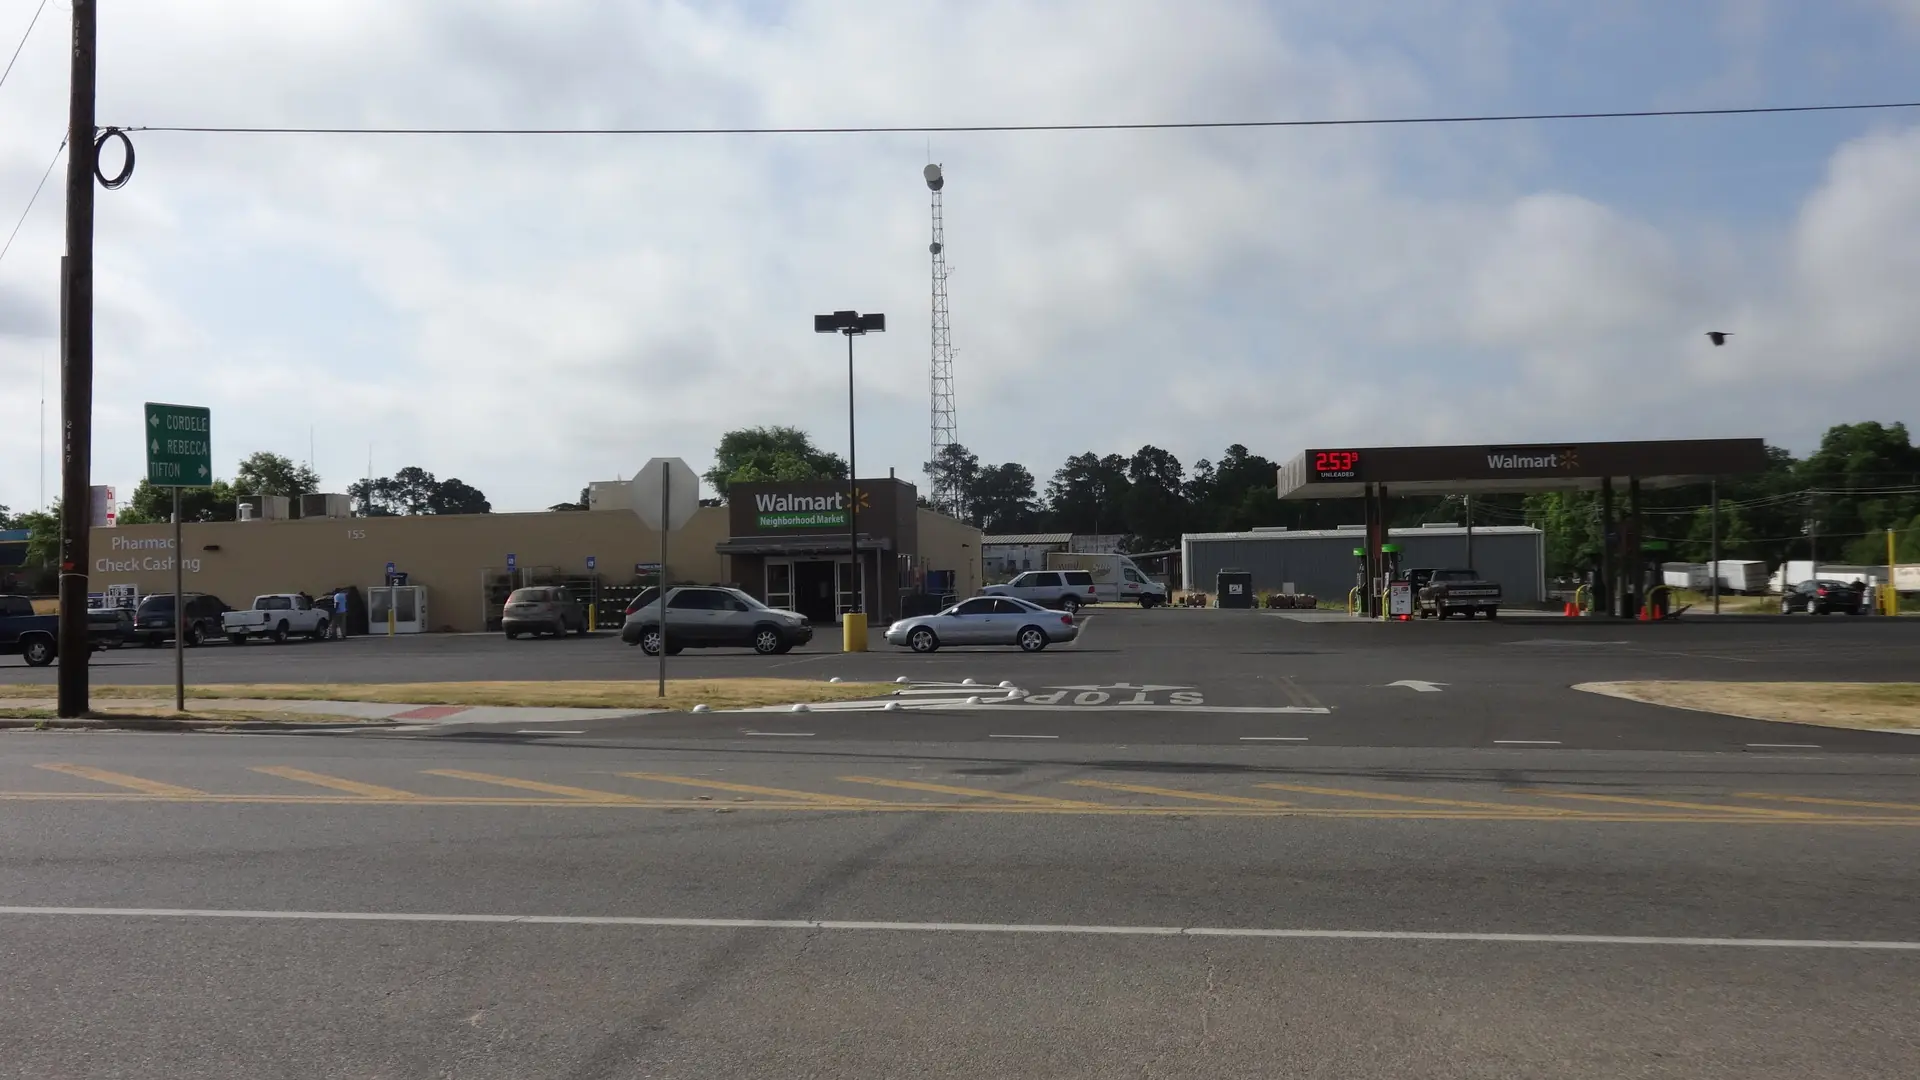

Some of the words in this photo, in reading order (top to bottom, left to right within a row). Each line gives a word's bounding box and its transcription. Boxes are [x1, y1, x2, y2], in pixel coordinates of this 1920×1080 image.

[166, 414, 208, 432] CORDELE
[167, 439, 208, 456] REBECCA
[1487, 453, 1557, 469] Walmart
[151, 462, 180, 478] TIFTON
[755, 492, 843, 512] Walmart
[760, 516, 816, 528] Neighborhood
[817, 514, 844, 524] Market
[347, 529, 366, 539] 155
[112, 536, 184, 550] Pharmac
[96, 557, 140, 572] Check
[143, 557, 201, 573] Cashng
[1023, 691, 1204, 705] STOP
